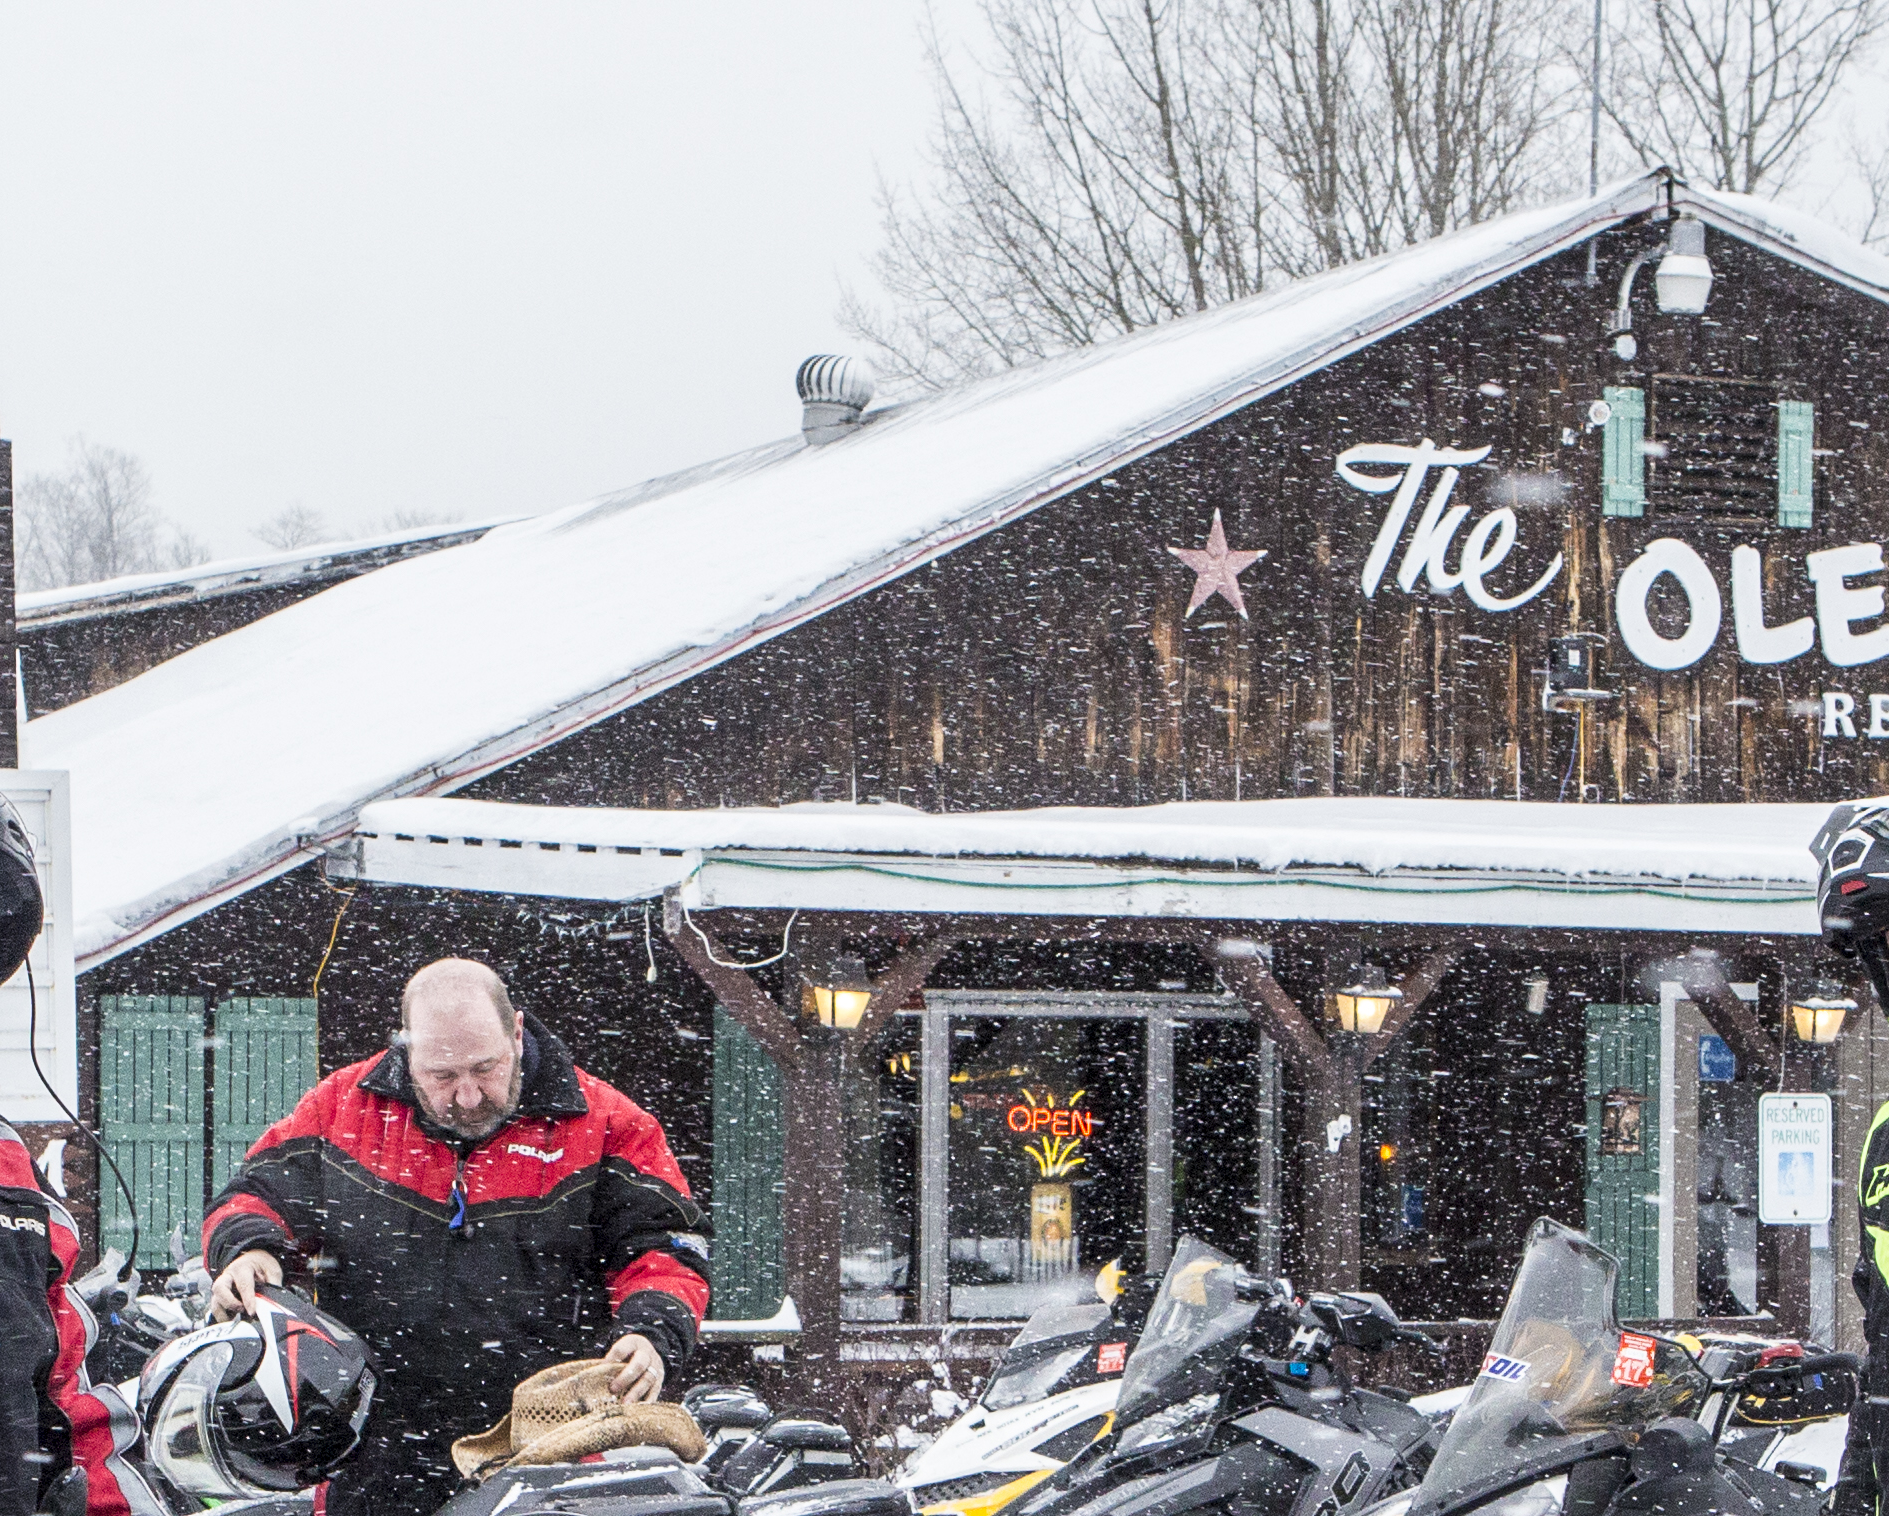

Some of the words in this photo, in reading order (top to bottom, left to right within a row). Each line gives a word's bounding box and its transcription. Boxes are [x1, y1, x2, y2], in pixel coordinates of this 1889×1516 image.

[1336, 437, 1562, 612] The
[1007, 1105, 1091, 1136] OPEN
[1766, 1108, 1825, 1123] RESERVED
[1772, 1129, 1820, 1144] PARKING
[1622, 1358, 1651, 1381] 17
